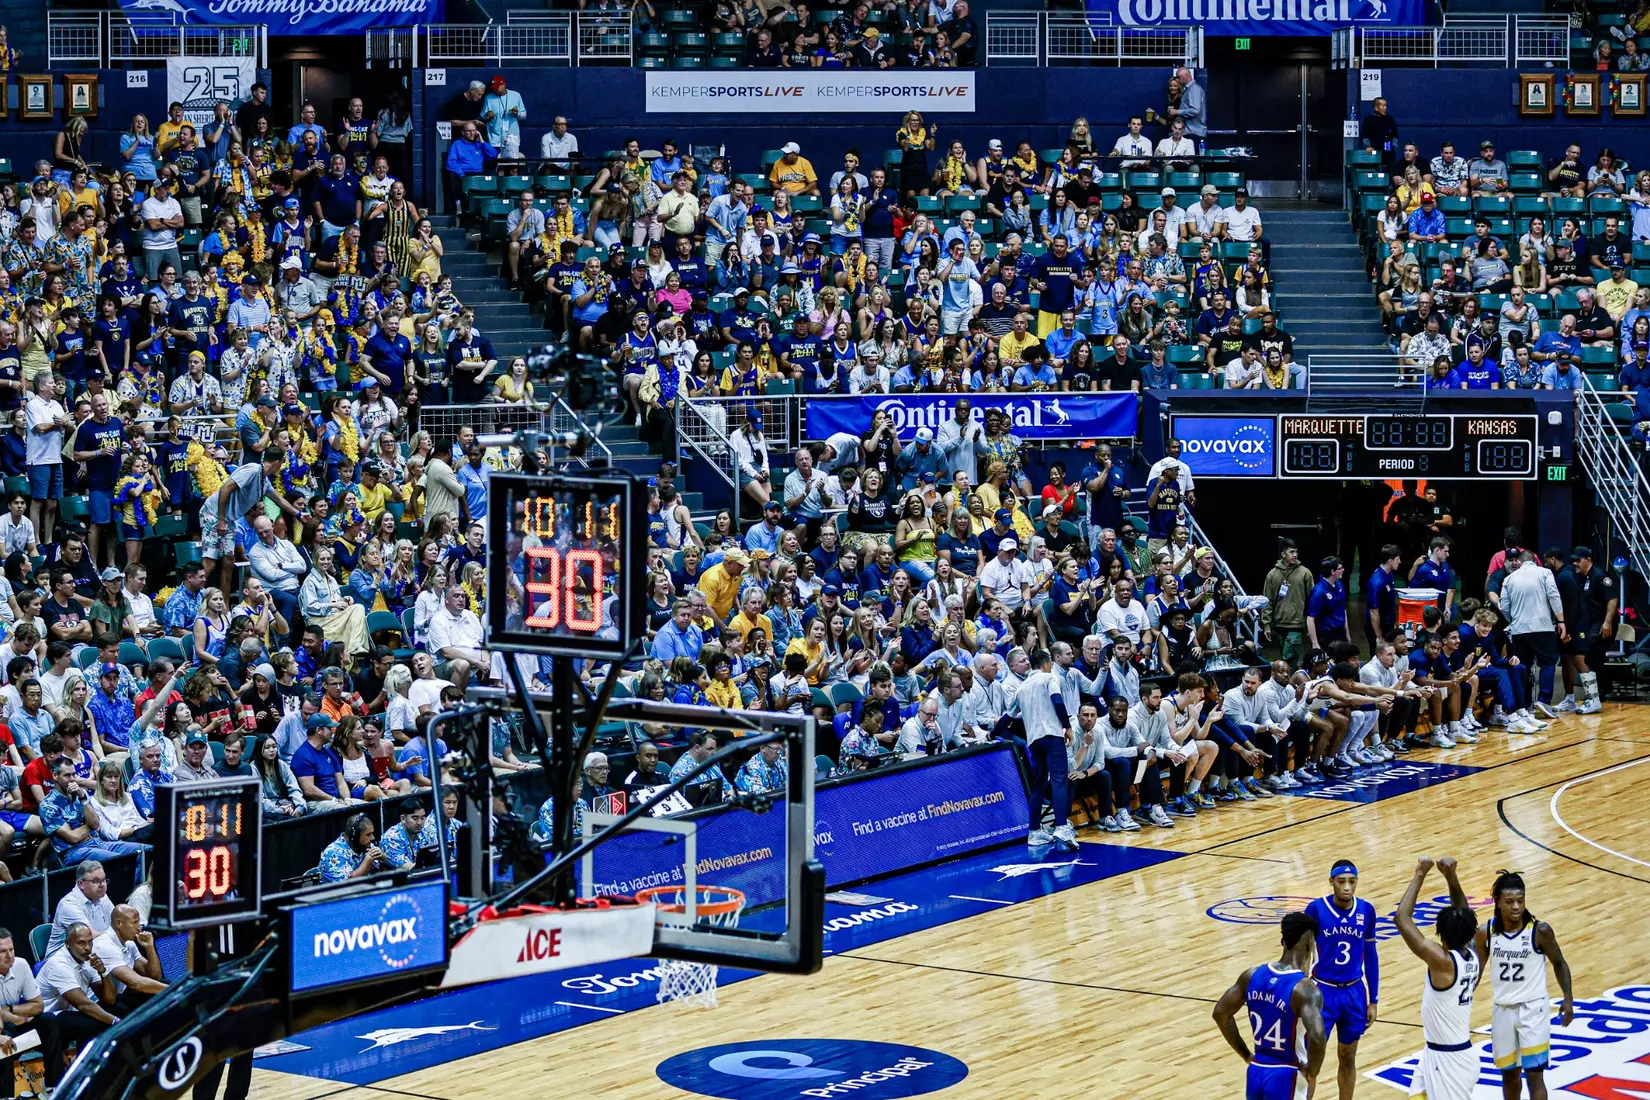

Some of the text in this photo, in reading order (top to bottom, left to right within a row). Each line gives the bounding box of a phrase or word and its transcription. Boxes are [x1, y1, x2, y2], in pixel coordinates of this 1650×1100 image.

[1235, 38, 1251, 50] EXIT
[129, 75, 146, 83] 216
[183, 66, 240, 102] 25
[1363, 73, 1380, 81] 219
[651, 86, 969, 97] KEMPERSPORTSLIVE KEMPERSPORTSLIVE
[182, 423, 196, 431] WE
[875, 398, 1043, 437] Contietal
[1284, 419, 1364, 434] MARQUETTE
[1468, 420, 1517, 435] KANSAS
[1179, 438, 1265, 453] novavax
[1379, 459, 1414, 470] PERIOD
[1547, 465, 1567, 481] EXIT
[525, 546, 604, 632] 30
[1304, 765, 1435, 798] novavax
[852, 790, 1005, 837] Find a vaccine at FindNovavax.com
[187, 846, 231, 899] 30
[594, 883, 618, 898] Find
[620, 885, 629, 893] a
[630, 871, 670, 891] vaccine
[671, 867, 683, 881] at
[314, 916, 417, 957] novavax
[1322, 926, 1364, 939] KANSAS
[516, 928, 562, 963] ACE
[1334, 941, 1351, 965] 3
[1492, 947, 1531, 960] Marquette
[1499, 962, 1525, 982] 22
[1249, 1010, 1287, 1051] 24
[800, 1057, 935, 1099] Principal
